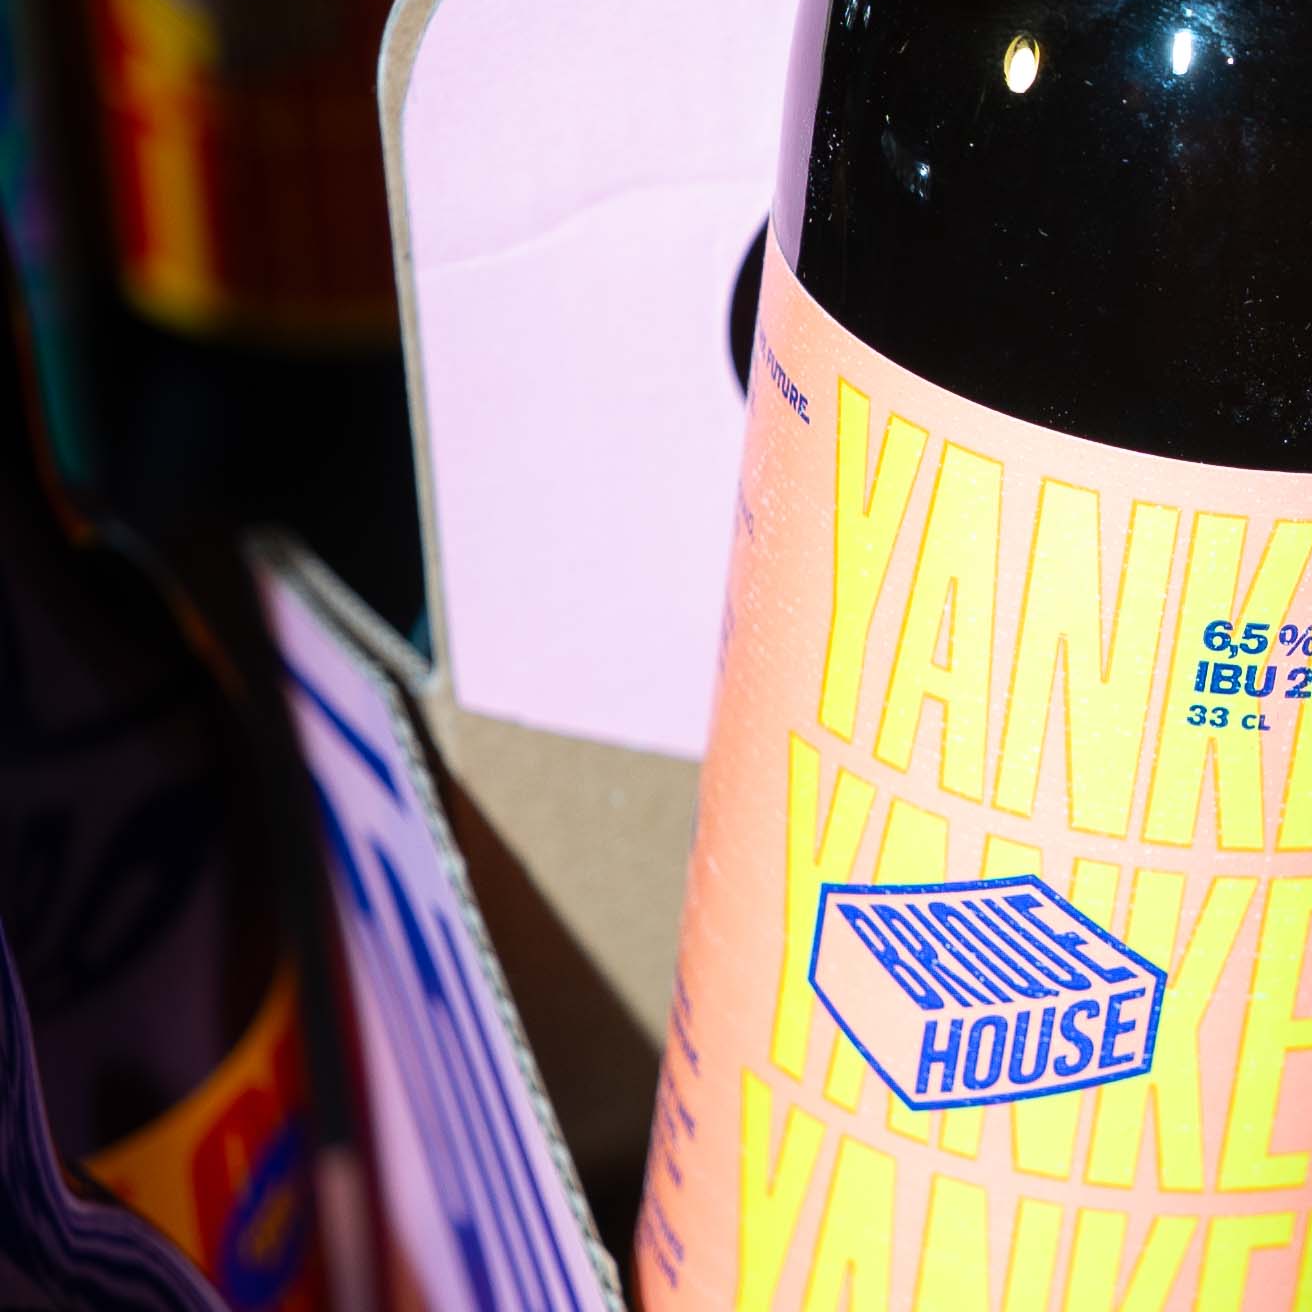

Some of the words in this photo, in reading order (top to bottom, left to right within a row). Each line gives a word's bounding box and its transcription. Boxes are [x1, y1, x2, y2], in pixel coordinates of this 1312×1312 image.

[1202, 618, 1271, 659] 6,5
[1193, 659, 1277, 699] IBU
[1186, 703, 1230, 730] 33
[836, 892, 1140, 1013] BRIQUE
[914, 986, 1148, 1096] HOUSE
